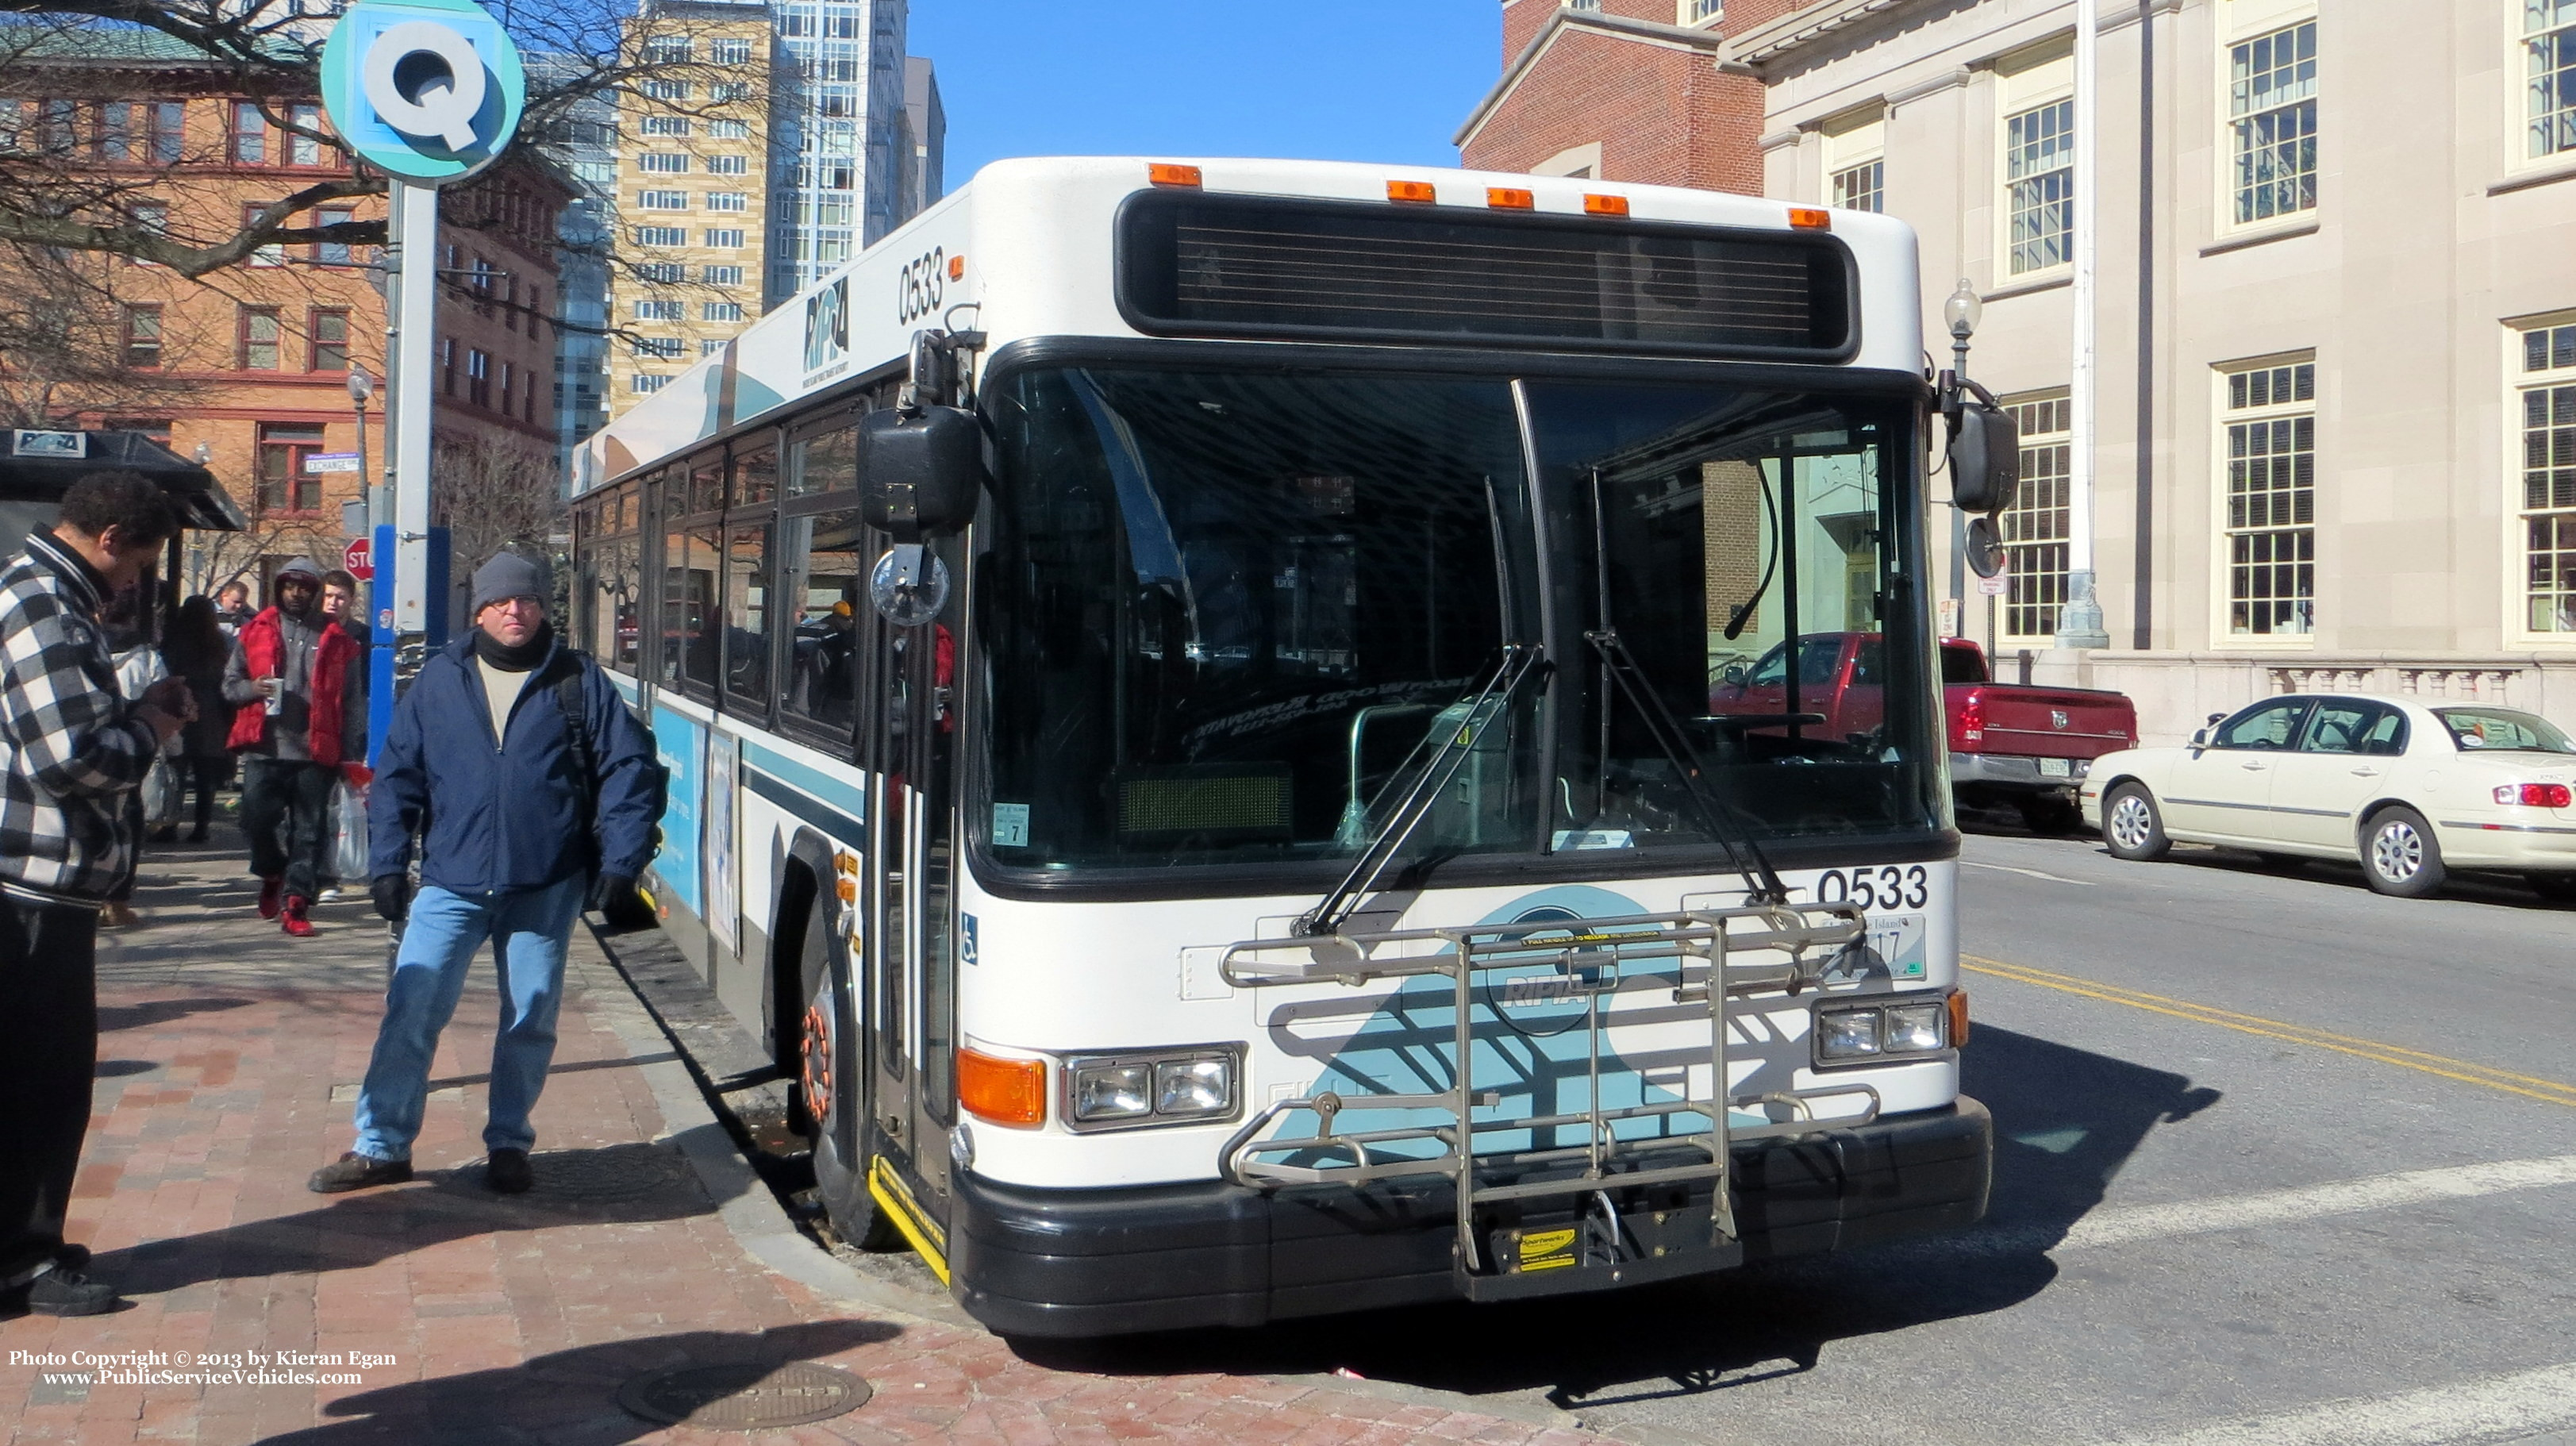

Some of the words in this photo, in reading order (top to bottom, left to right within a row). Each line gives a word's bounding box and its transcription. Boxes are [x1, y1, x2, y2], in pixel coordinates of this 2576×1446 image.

[364, 21, 486, 152] Q
[899, 245, 944, 326] 0533
[348, 552, 375, 568] STO
[1012, 825, 1019, 841] 7
[1817, 865, 1928, 911] 0533
[1874, 918, 1901, 929] Island
[1502, 974, 1586, 1009] RIPTA
